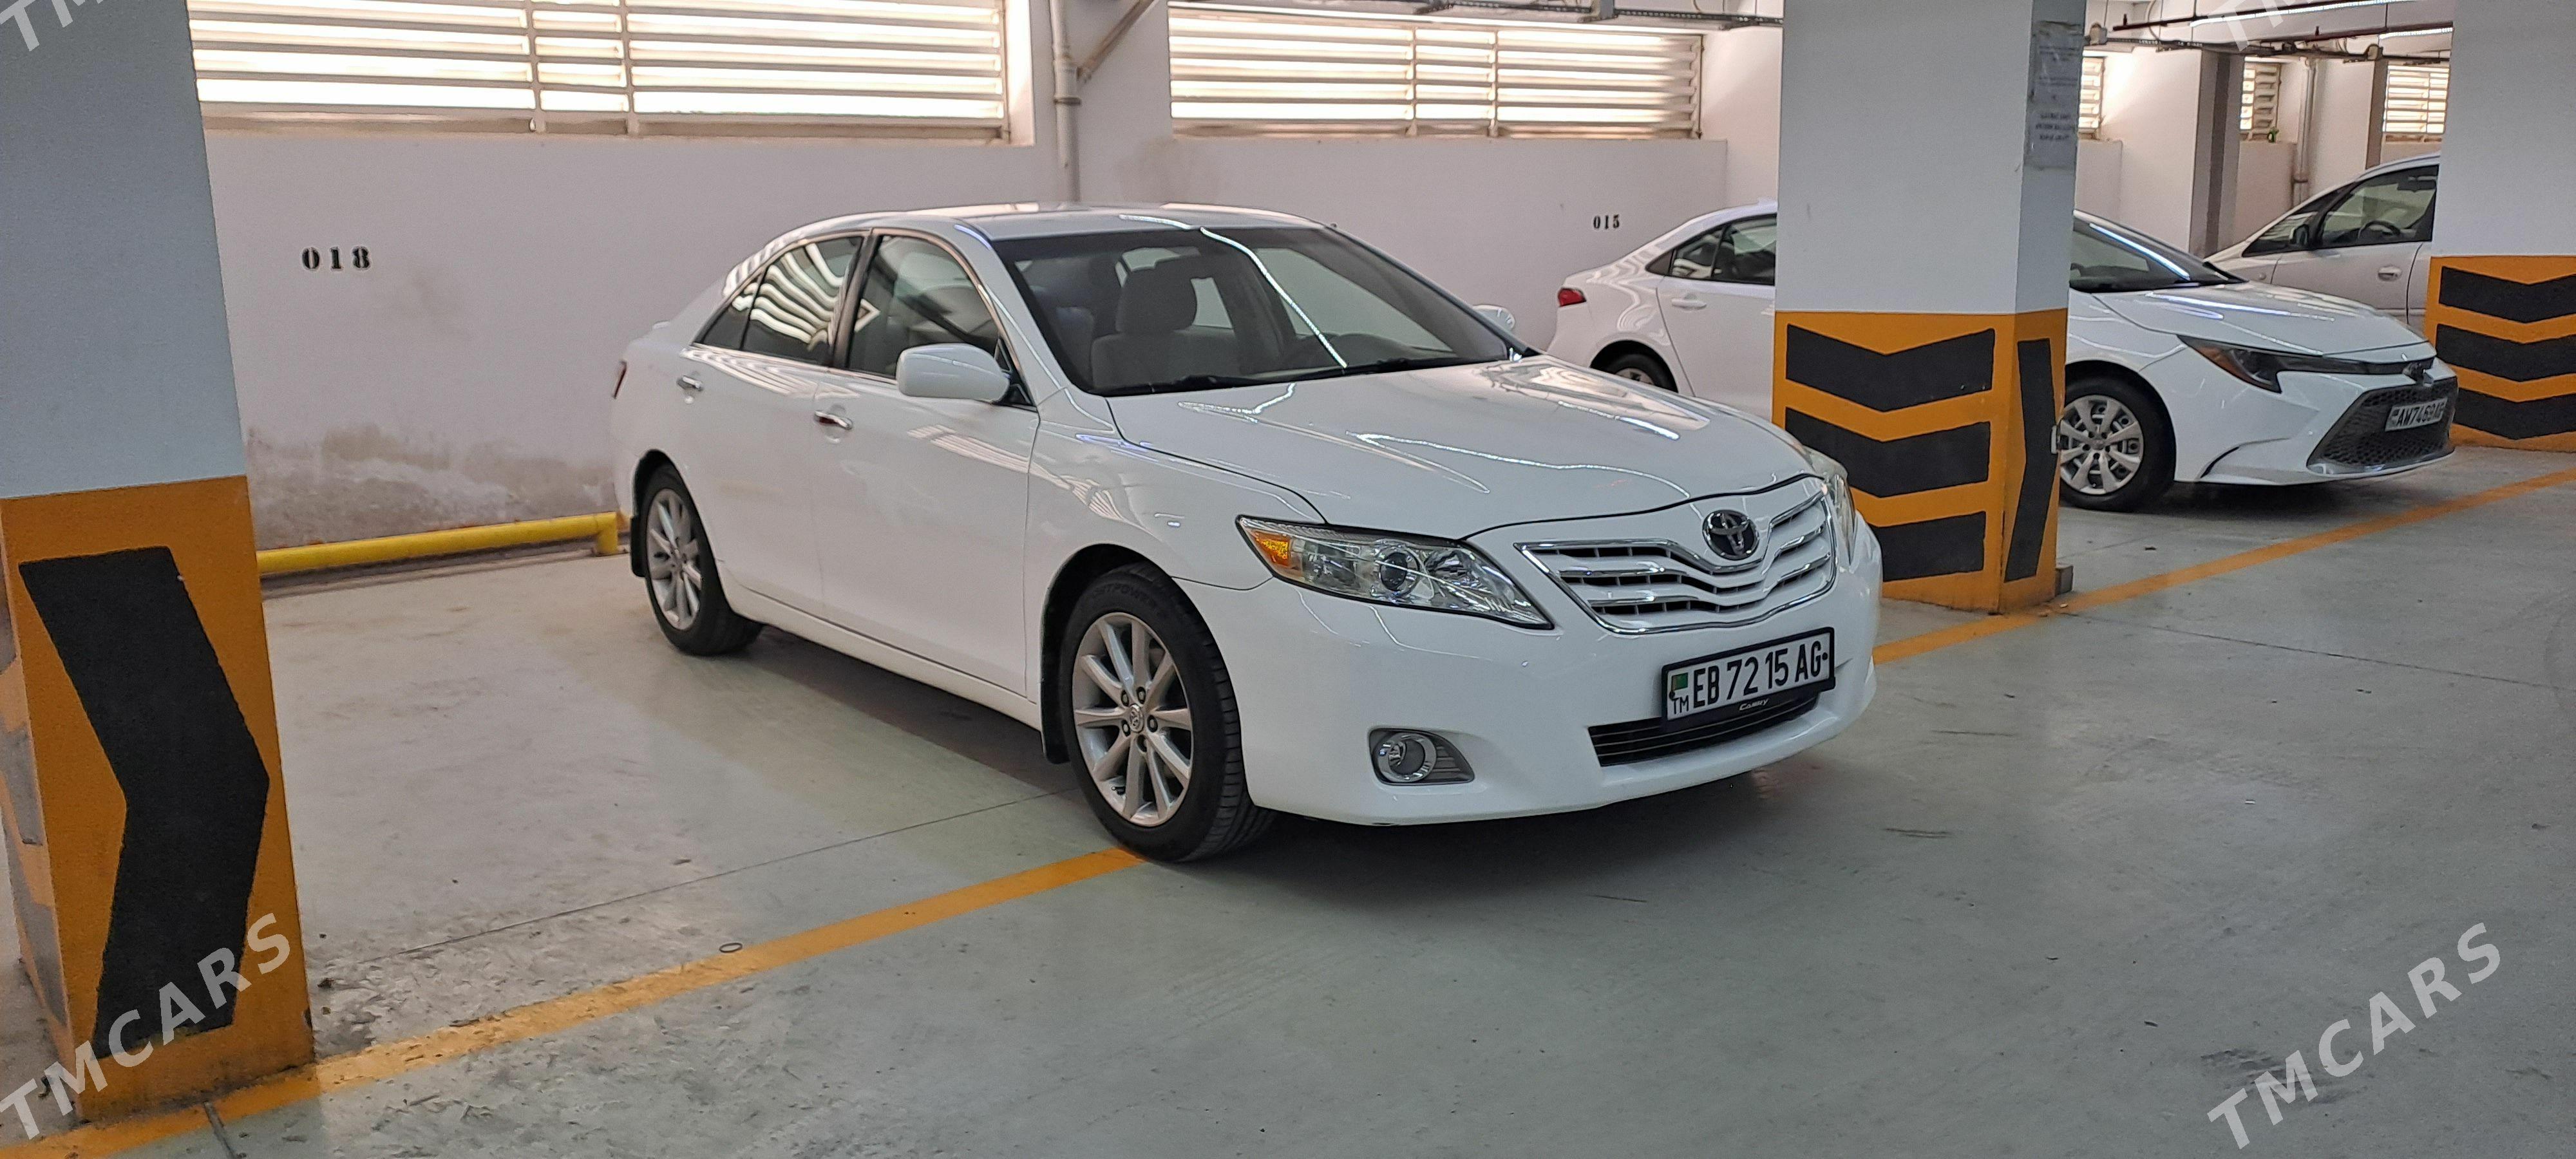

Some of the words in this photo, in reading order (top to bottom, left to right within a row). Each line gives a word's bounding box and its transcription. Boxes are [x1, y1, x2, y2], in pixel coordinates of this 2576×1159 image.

[1593, 214, 1620, 229] 015
[301, 247, 370, 269] 018
[1694, 665, 1719, 708] EB
[1727, 656, 1759, 700] 72
[1765, 648, 1789, 689] 15
[1794, 641, 1821, 683] AG
[1672, 695, 1689, 714] TM
